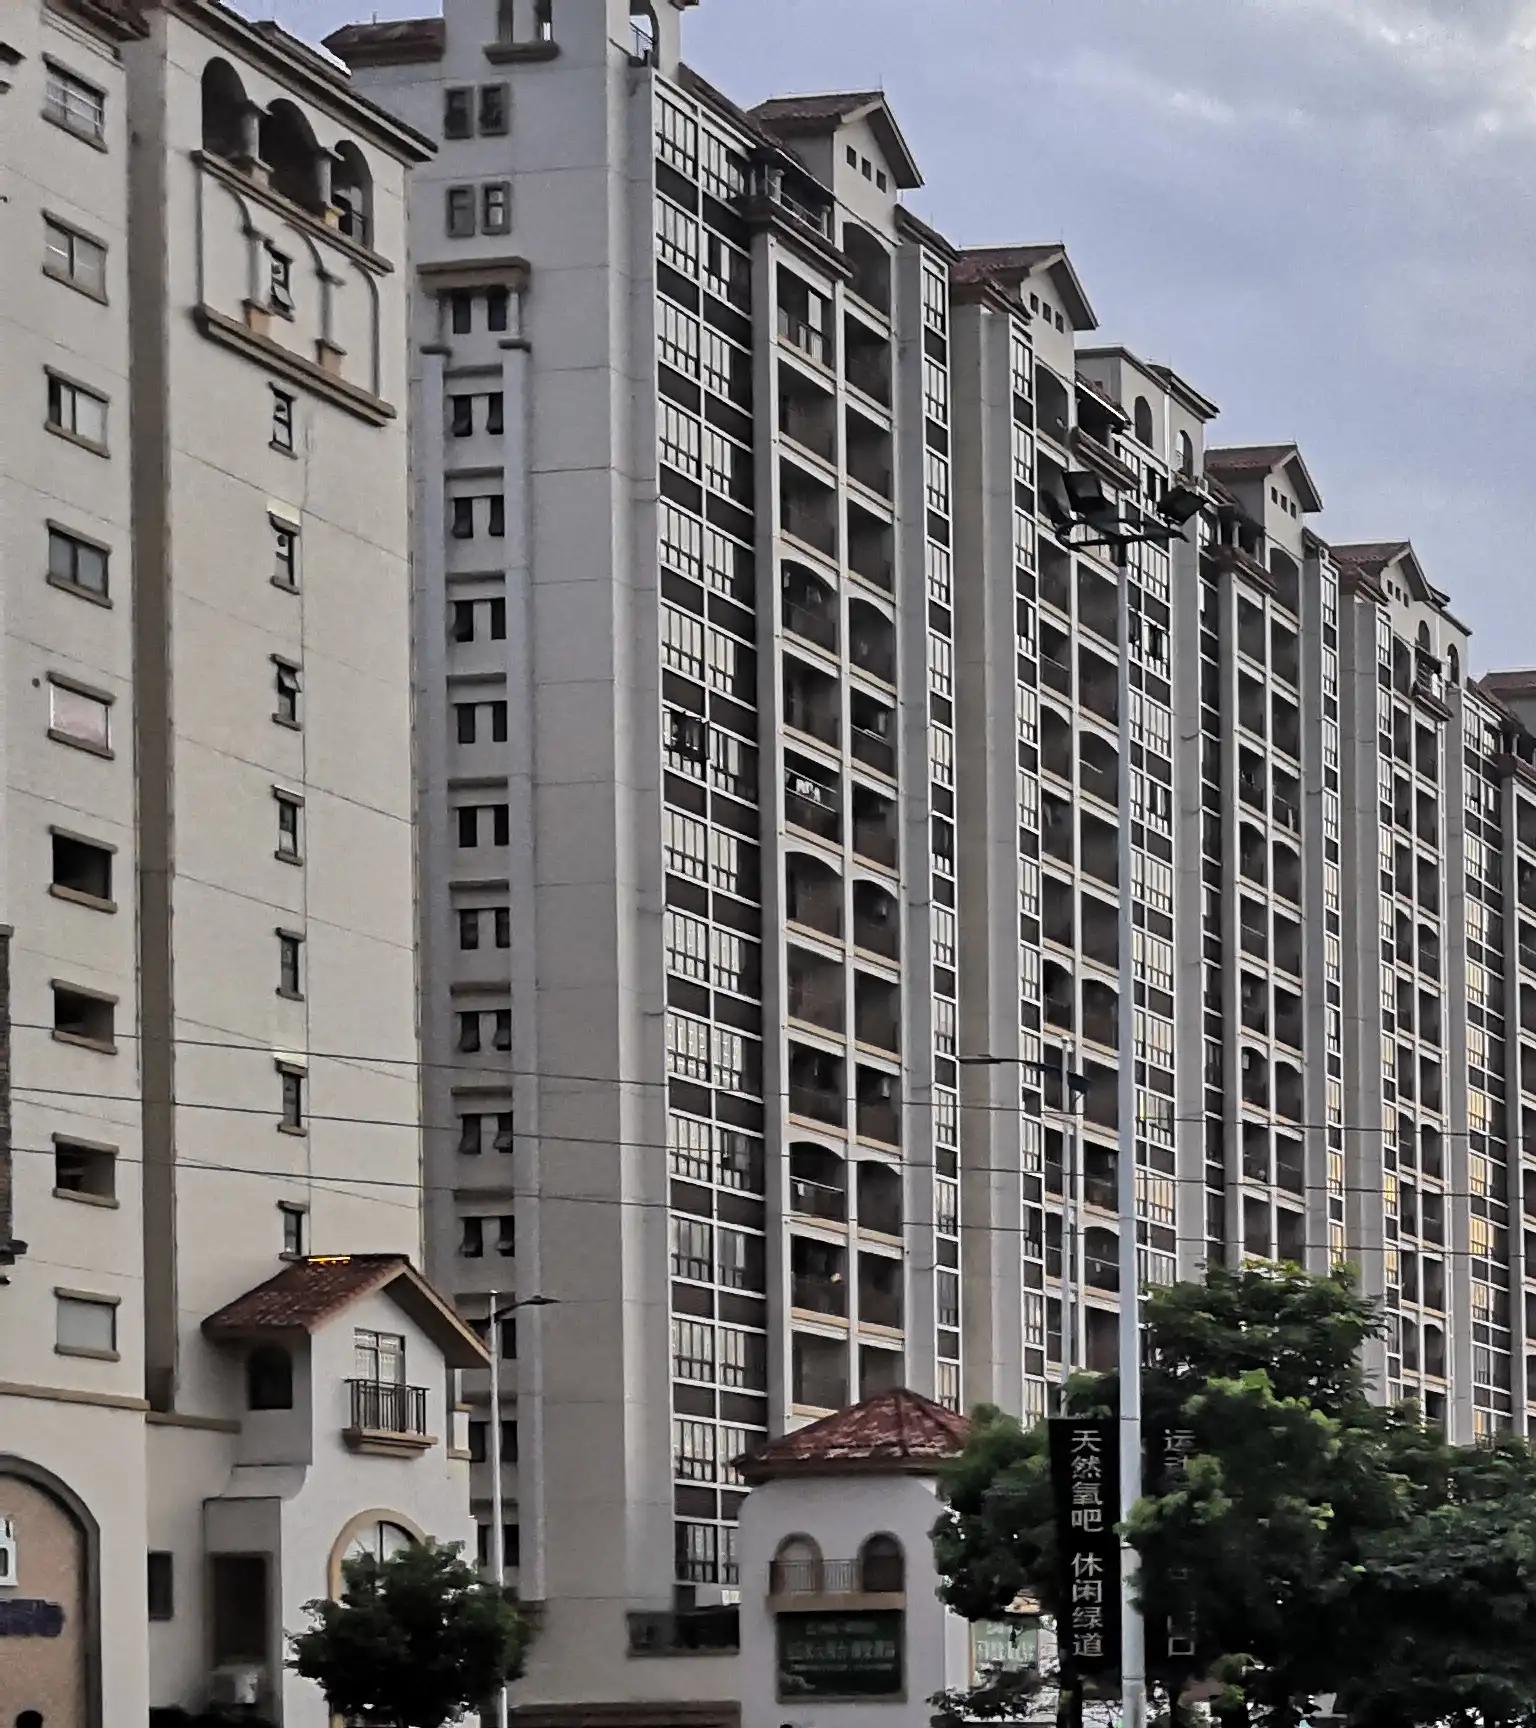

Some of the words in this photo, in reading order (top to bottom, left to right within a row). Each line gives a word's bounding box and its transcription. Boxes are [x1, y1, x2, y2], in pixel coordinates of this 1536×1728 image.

[1070, 1429, 1105, 1533] 天然氧吧
[1070, 1552, 1105, 1657] 休闲绿道
